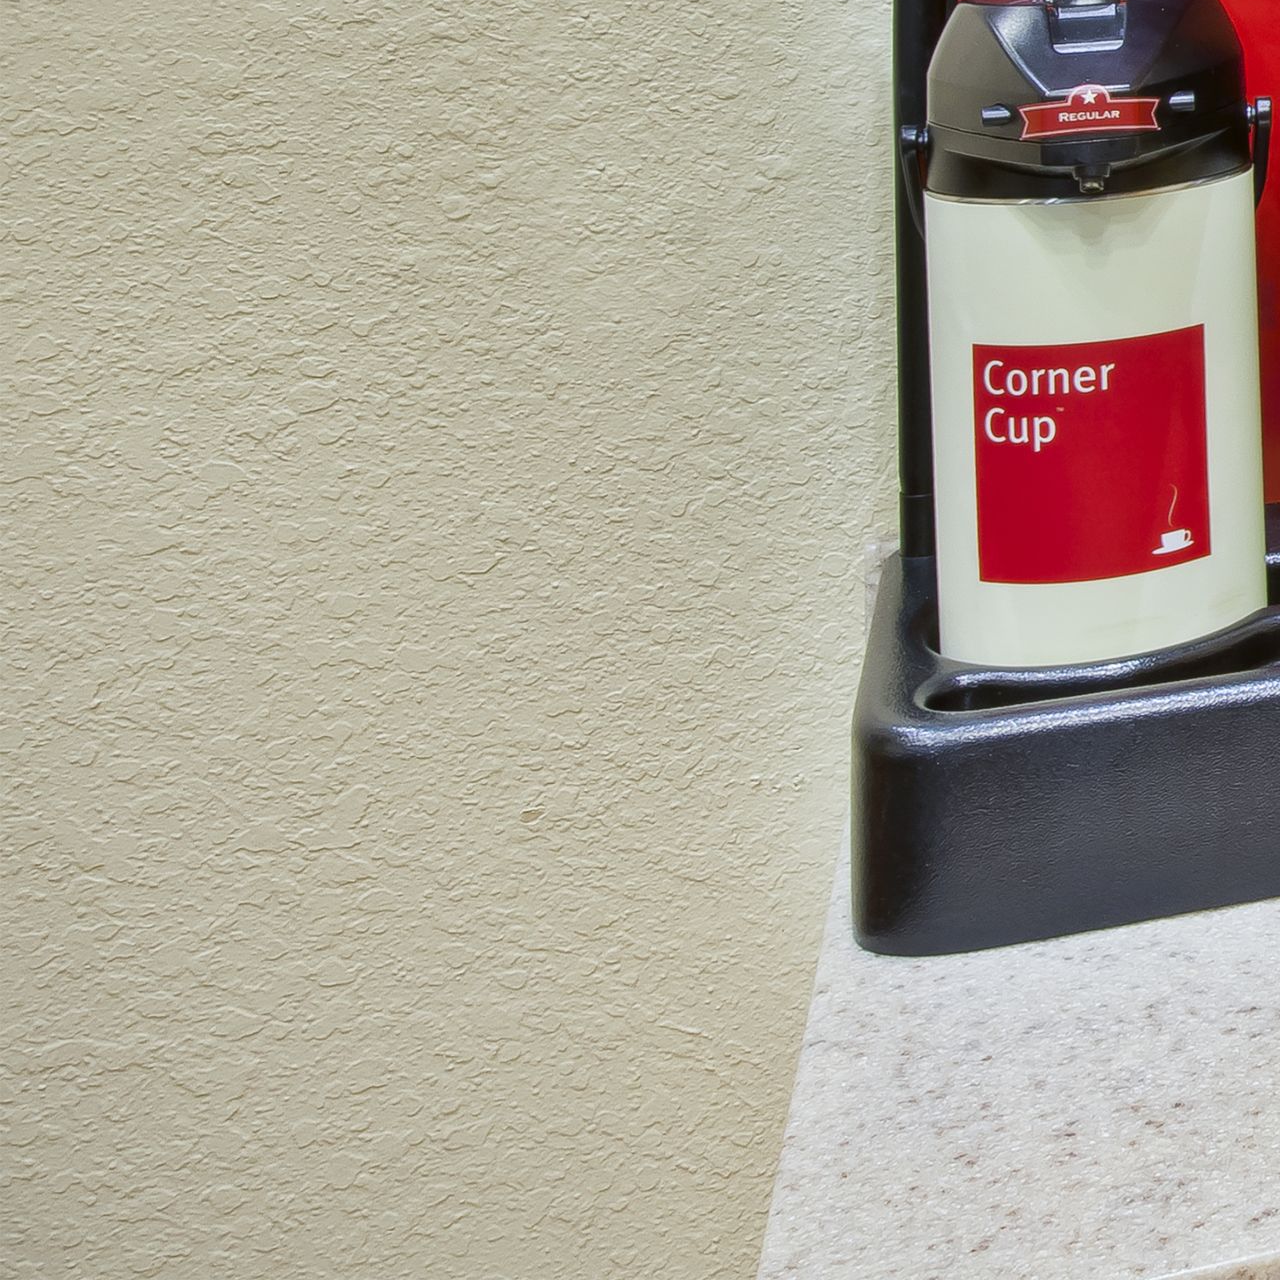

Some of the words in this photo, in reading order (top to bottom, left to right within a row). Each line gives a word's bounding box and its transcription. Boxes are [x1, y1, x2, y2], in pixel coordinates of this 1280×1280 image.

[1058, 110, 1120, 123] REGULAR
[983, 359, 1116, 397] Corner
[984, 406, 1057, 453] Cup
